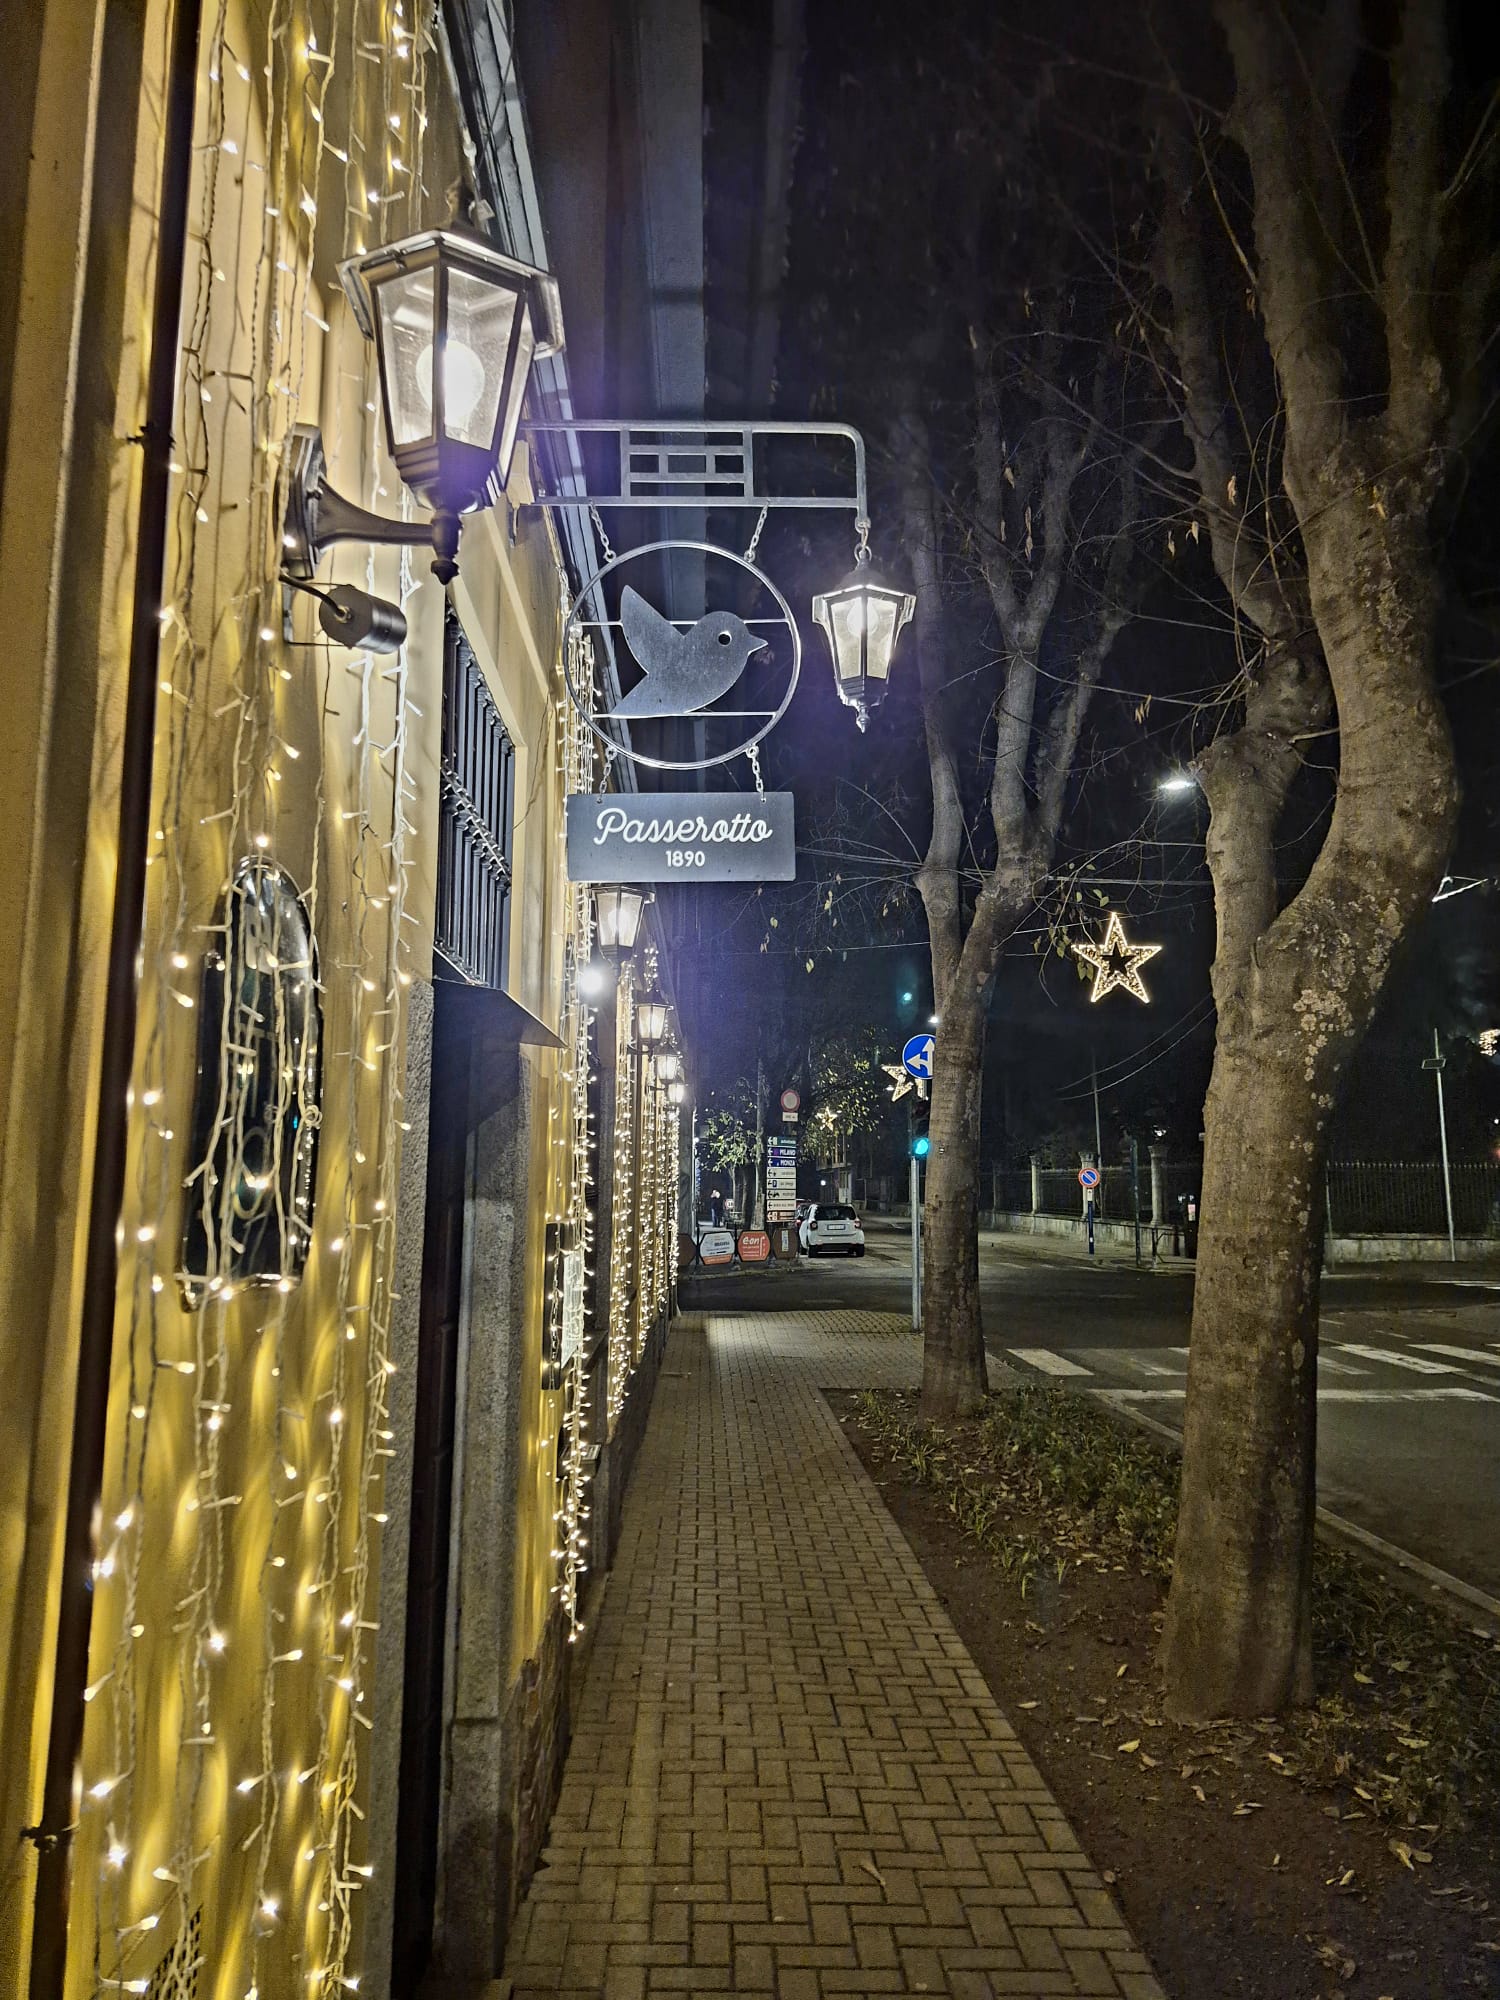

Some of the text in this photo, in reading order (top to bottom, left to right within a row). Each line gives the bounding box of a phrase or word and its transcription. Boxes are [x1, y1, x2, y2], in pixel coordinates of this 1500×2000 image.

[593, 807, 773, 846] Passerotto
[665, 850, 706, 868] 1890
[780, 1148, 796, 1156] MILANO
